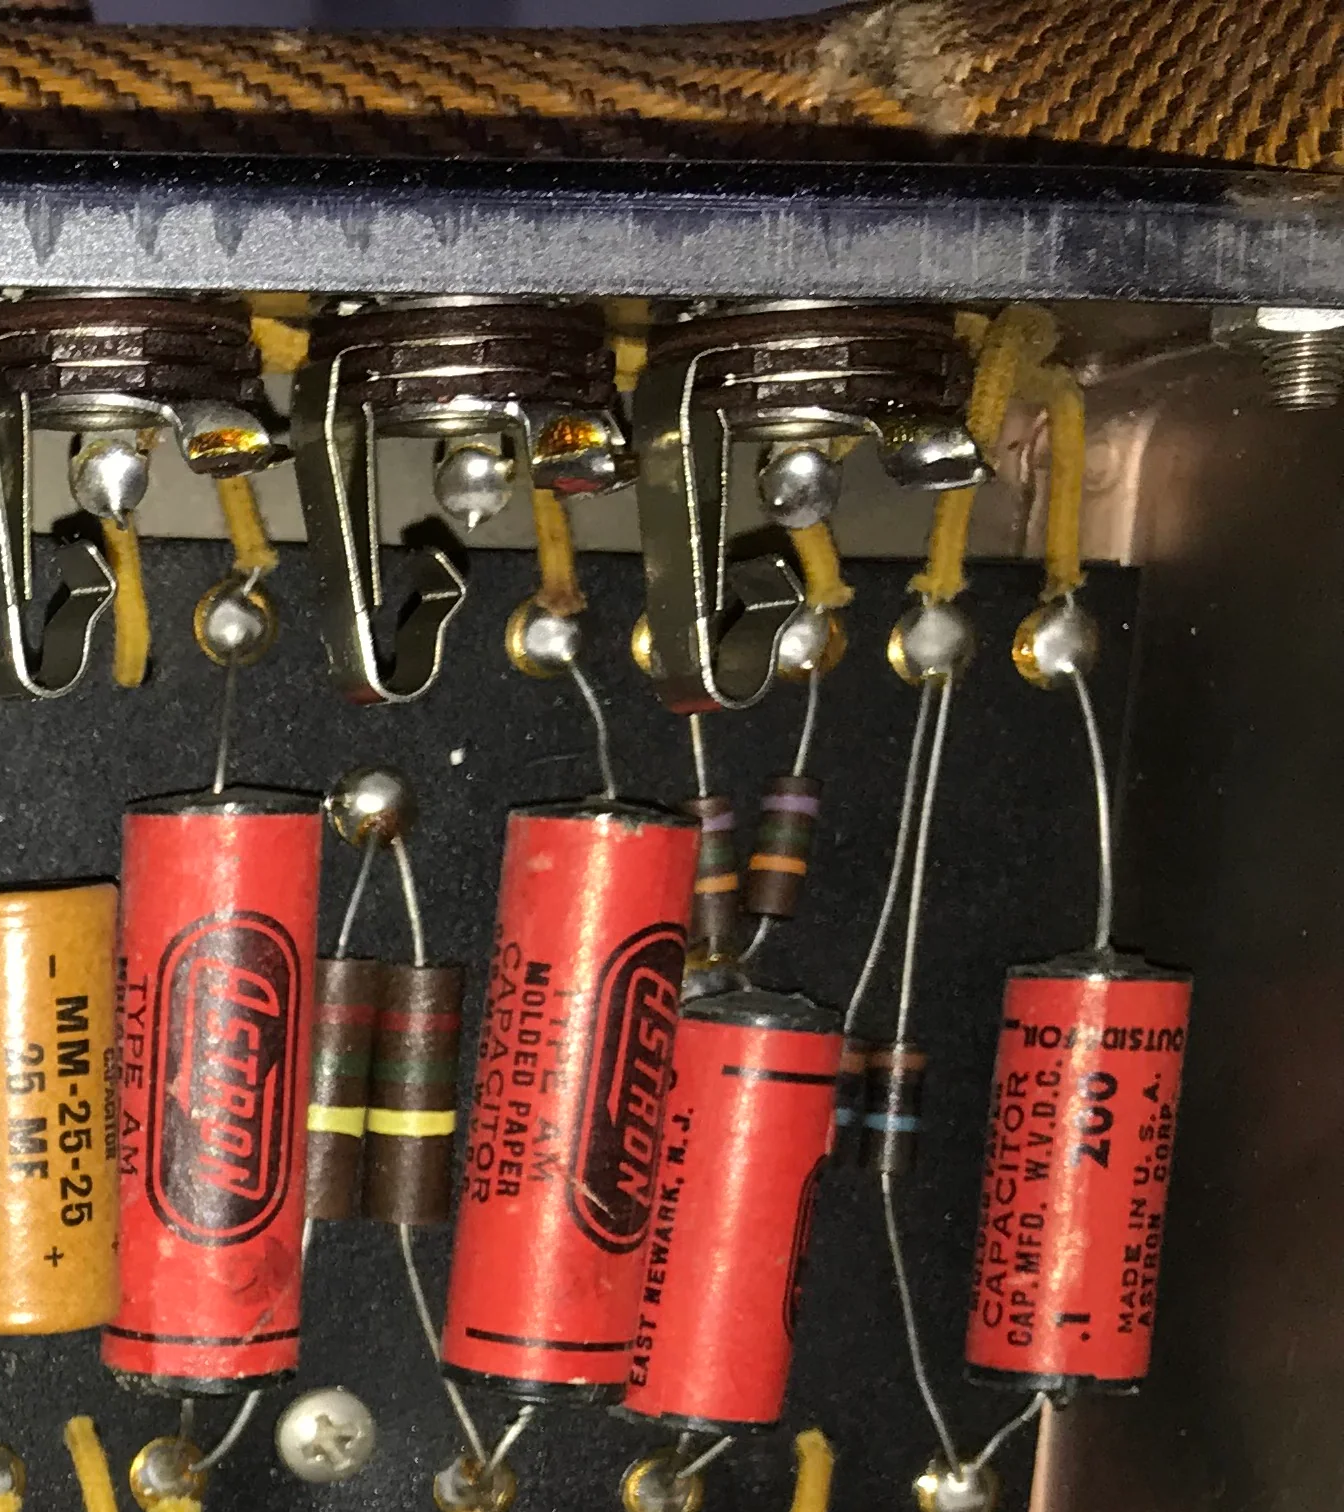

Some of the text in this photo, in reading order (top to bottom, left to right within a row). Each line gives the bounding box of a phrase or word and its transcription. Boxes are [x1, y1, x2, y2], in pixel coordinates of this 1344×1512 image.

[124, 975, 147, 1090] TYPE
[189, 958, 279, 1203] ASTRON
[472, 942, 522, 1204] CAPACITOR
[495, 961, 552, 1198] MOLDED PAPER
[1087, 1026, 1184, 1052] OUTSID
[5, 1043, 49, 1179] 25 MF
[56, 995, 93, 1227] MM-25-25
[120, 1110, 140, 1176] AM
[527, 1118, 562, 1184] AM
[1024, 1059, 1062, 1181] W.V.D.C.
[983, 1071, 1029, 1328] CAPACITOR
[1054, 1072, 1118, 1341] .1 200
[1128, 1198, 1147, 1229] IN
[628, 1313, 657, 1387] EAST
[645, 1177, 685, 1304] NEWARK,
[1118, 1244, 1143, 1333] MADE
[1138, 1214, 1160, 1327] ASTRON
